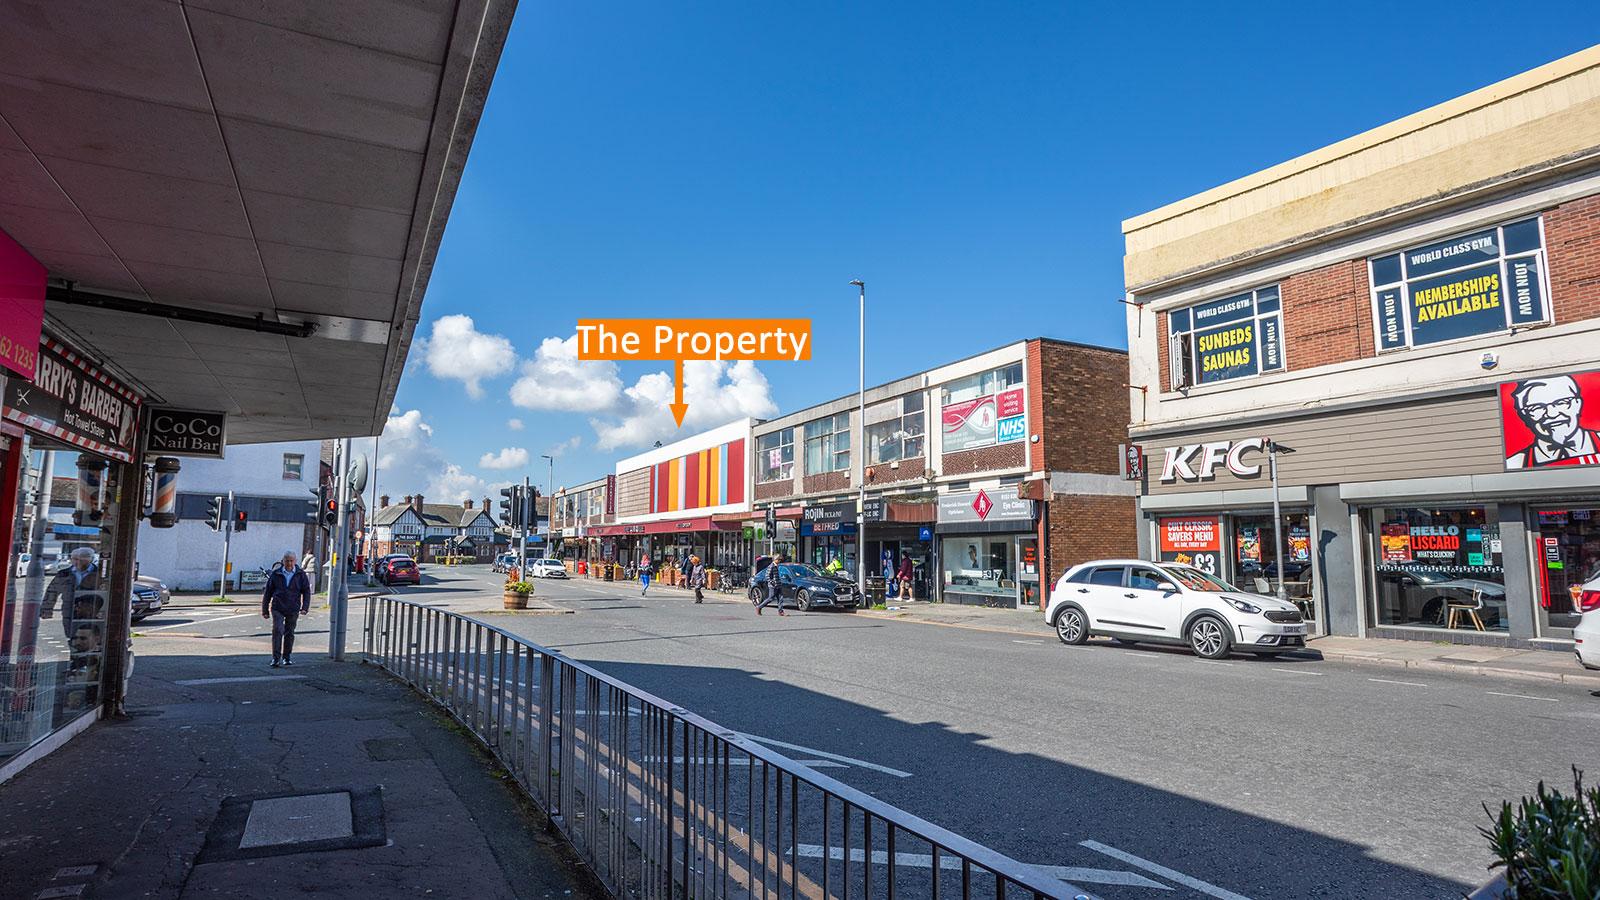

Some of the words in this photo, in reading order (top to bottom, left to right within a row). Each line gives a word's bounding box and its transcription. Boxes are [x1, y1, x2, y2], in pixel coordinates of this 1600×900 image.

[1411, 250, 1442, 266] WORLD
[1443, 242, 1471, 258] CLASS
[1471, 236, 1493, 250] GYM
[1515, 263, 1528, 288] JOIN
[1415, 273, 1499, 307] MEMBERSHIPS
[1517, 288, 1532, 315] NOW
[1197, 308, 1217, 319] WORLD
[1217, 302, 1236, 314] CLASS
[1236, 299, 1250, 310] GYM
[1384, 294, 1396, 317] JOIN
[1417, 291, 1500, 323] AVAILABLE
[1199, 326, 1252, 352] SUNBEDS
[1267, 322, 1276, 342] JOIN
[1387, 318, 1398, 342] NOW
[14, 343, 35, 370] 1235
[1203, 347, 1250, 372] SAUNAS
[1268, 343, 1277, 365] NOW
[80, 380, 122, 428] BARBER
[64, 408, 75, 426] Hot
[75, 413, 91, 433] Towel
[90, 421, 105, 439] Shave
[154, 415, 221, 437] CoCo
[999, 418, 1025, 436] NHS
[152, 434, 187, 449] Nail
[191, 437, 219, 451] Bar
[1160, 437, 1263, 482] KFC
[813, 522, 840, 532] BETFRED
[1168, 521, 1183, 531] CULT
[1184, 521, 1213, 531] CLASSIC
[1168, 531, 1193, 542] SAVERS
[1194, 531, 1214, 542] MENU
[1410, 525, 1460, 536] HELLO
[1411, 535, 1460, 550] LISCARD
[1194, 553, 1216, 575] £3
